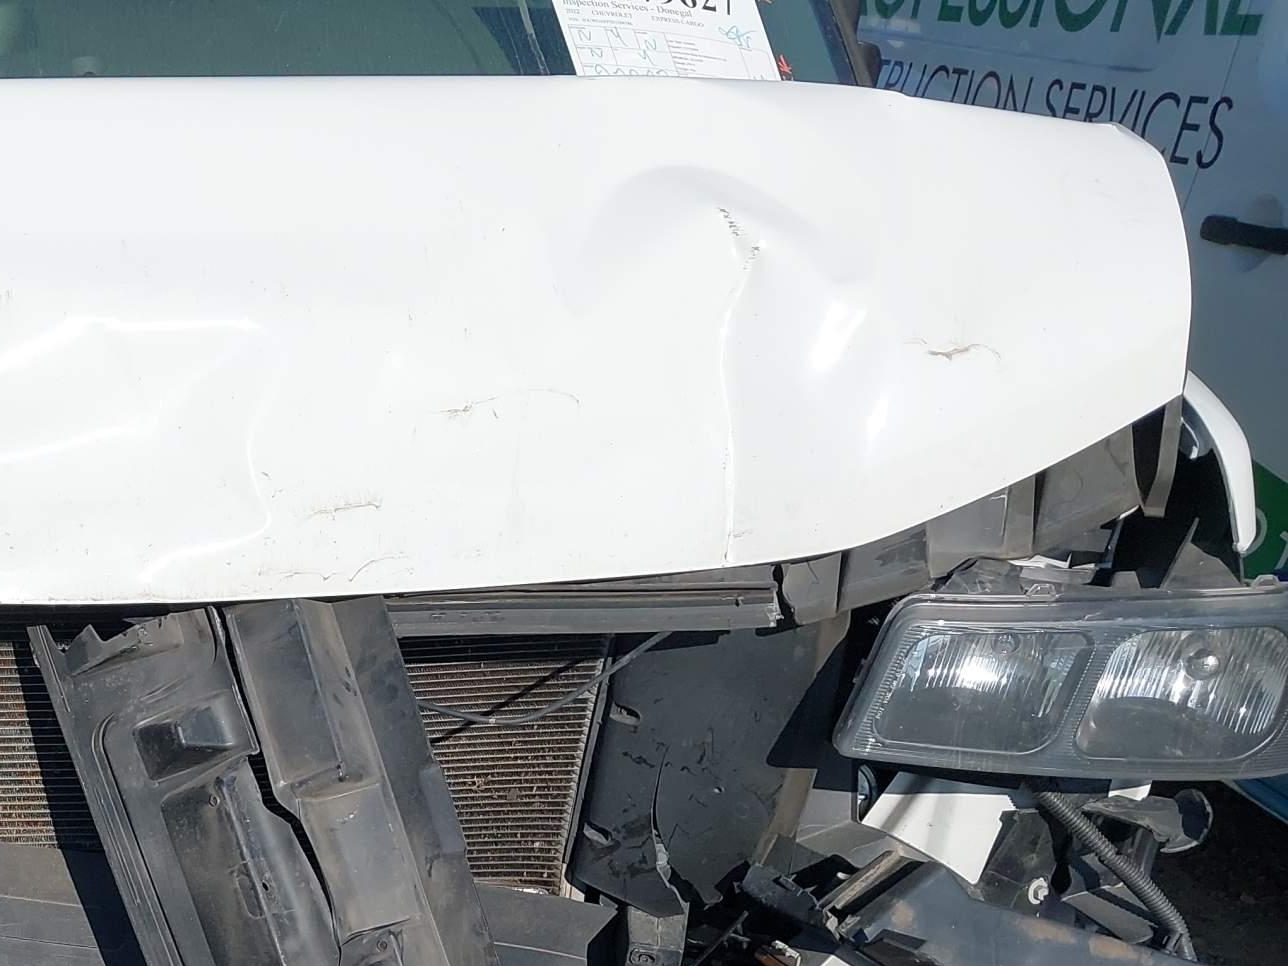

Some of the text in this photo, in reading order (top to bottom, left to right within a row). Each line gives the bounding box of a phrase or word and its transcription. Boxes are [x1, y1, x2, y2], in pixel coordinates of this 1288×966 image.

[611, 1, 649, 12] Services
[656, 5, 693, 17] Donegal
[1046, 78, 1234, 170] SERVICES
